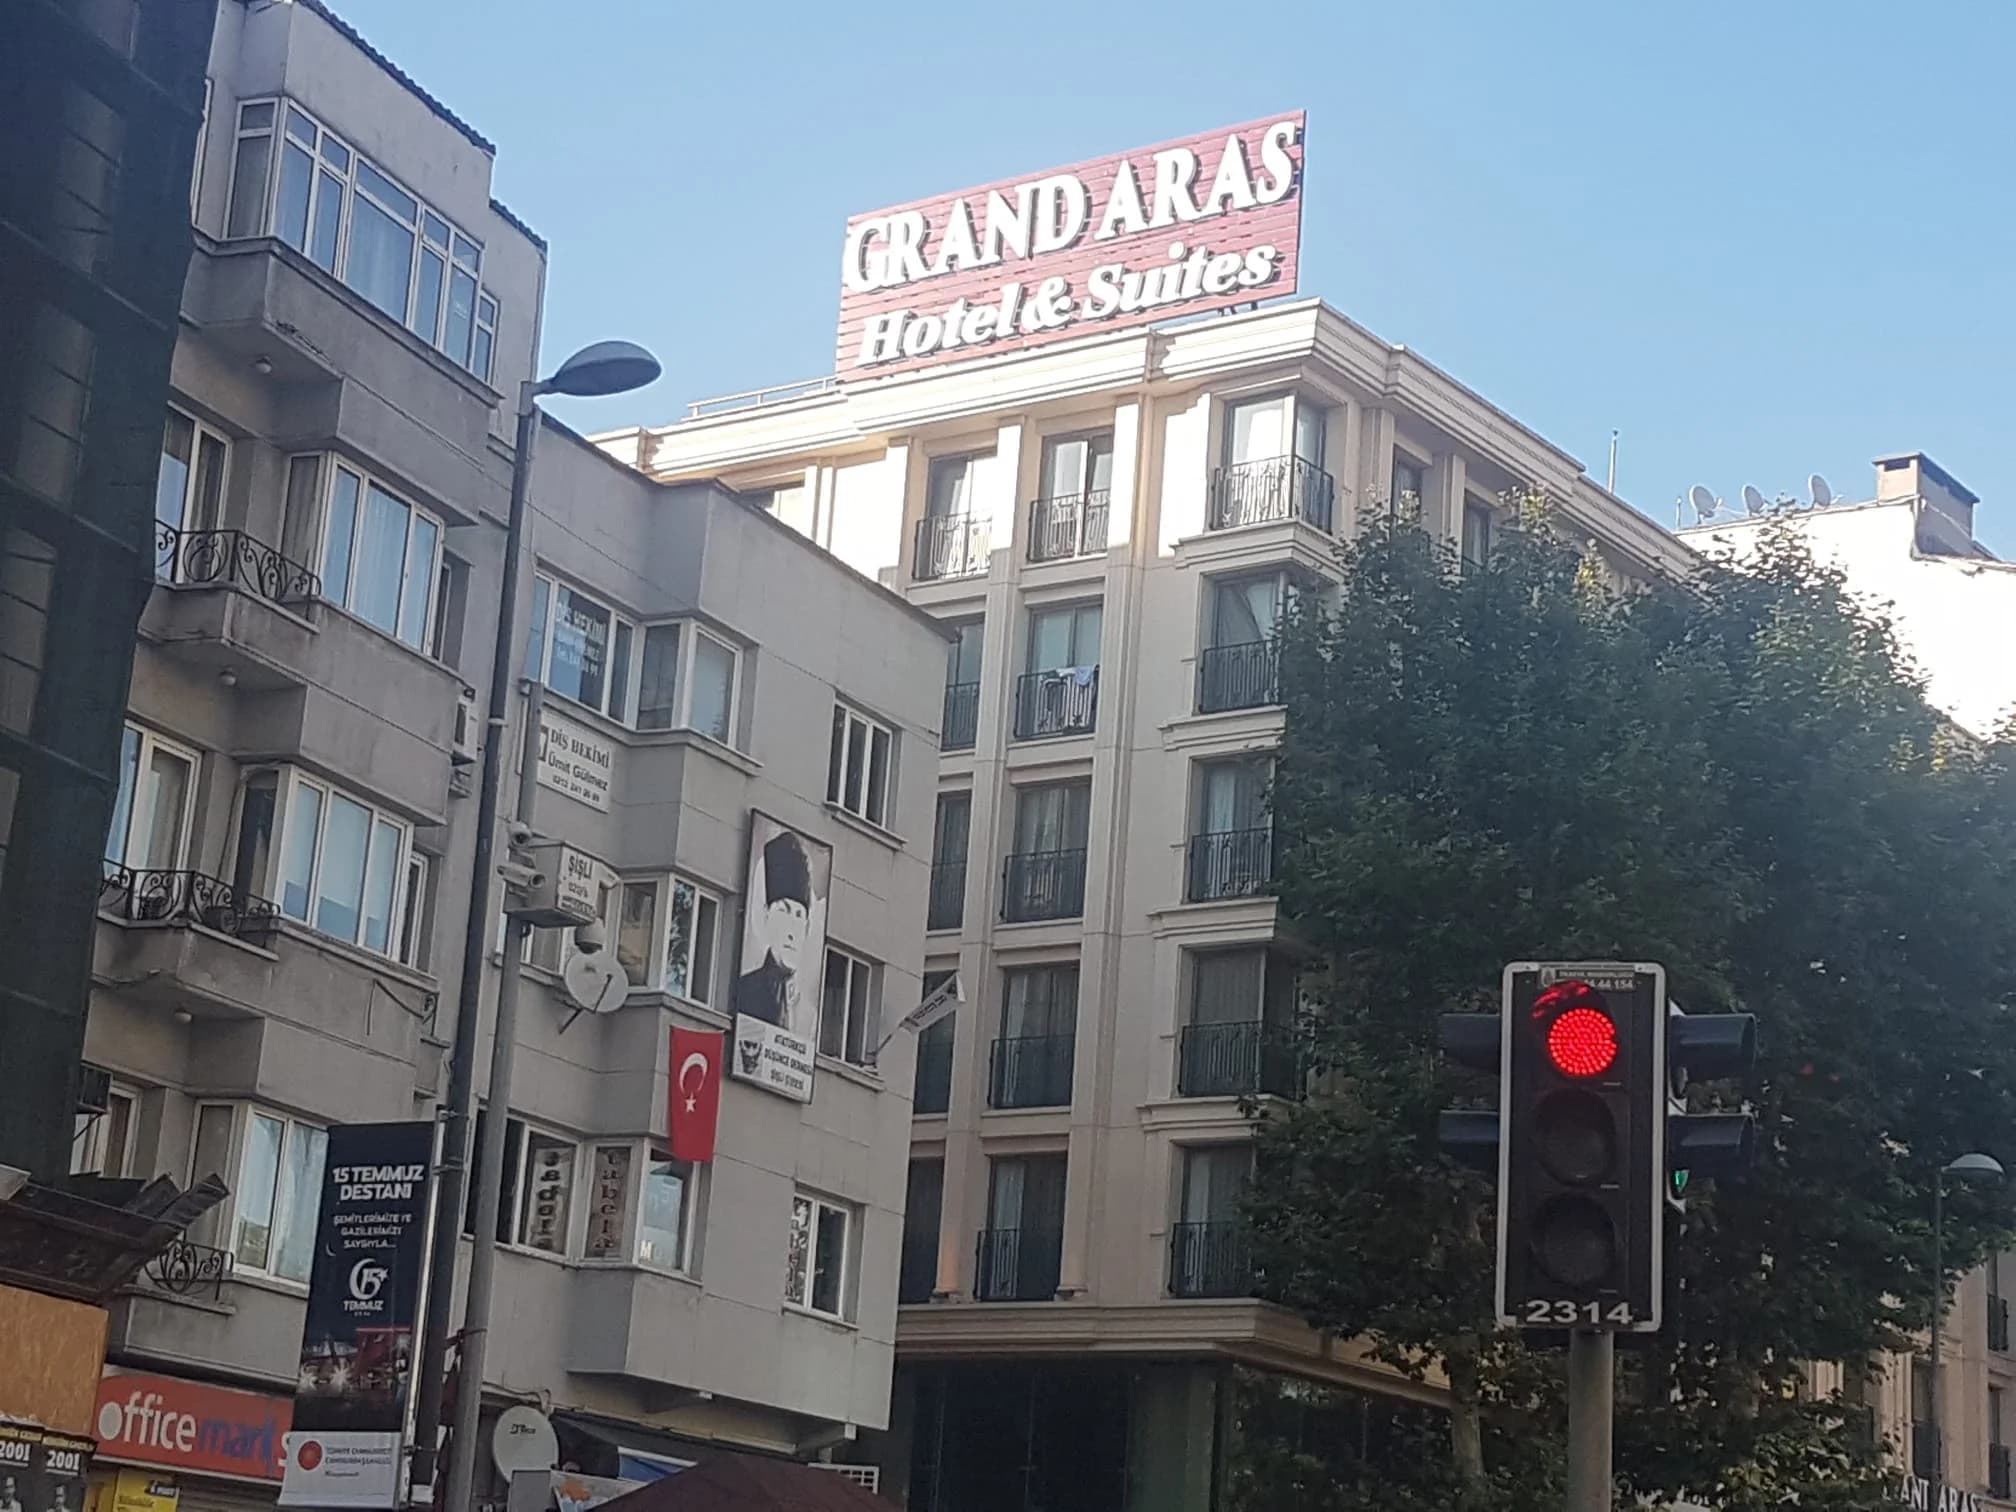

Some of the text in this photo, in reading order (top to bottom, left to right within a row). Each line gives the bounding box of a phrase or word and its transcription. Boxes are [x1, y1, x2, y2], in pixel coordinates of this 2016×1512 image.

[843, 121, 1296, 292] GRAND ARAS
[855, 241, 1281, 368] Hotel & Suites
[332, 1164, 424, 1183] 15 TEMMUZ
[340, 1183, 413, 1200] DESTANI
[1526, 1299, 1633, 1325] 2314
[47, 1450, 80, 1471] 2001
